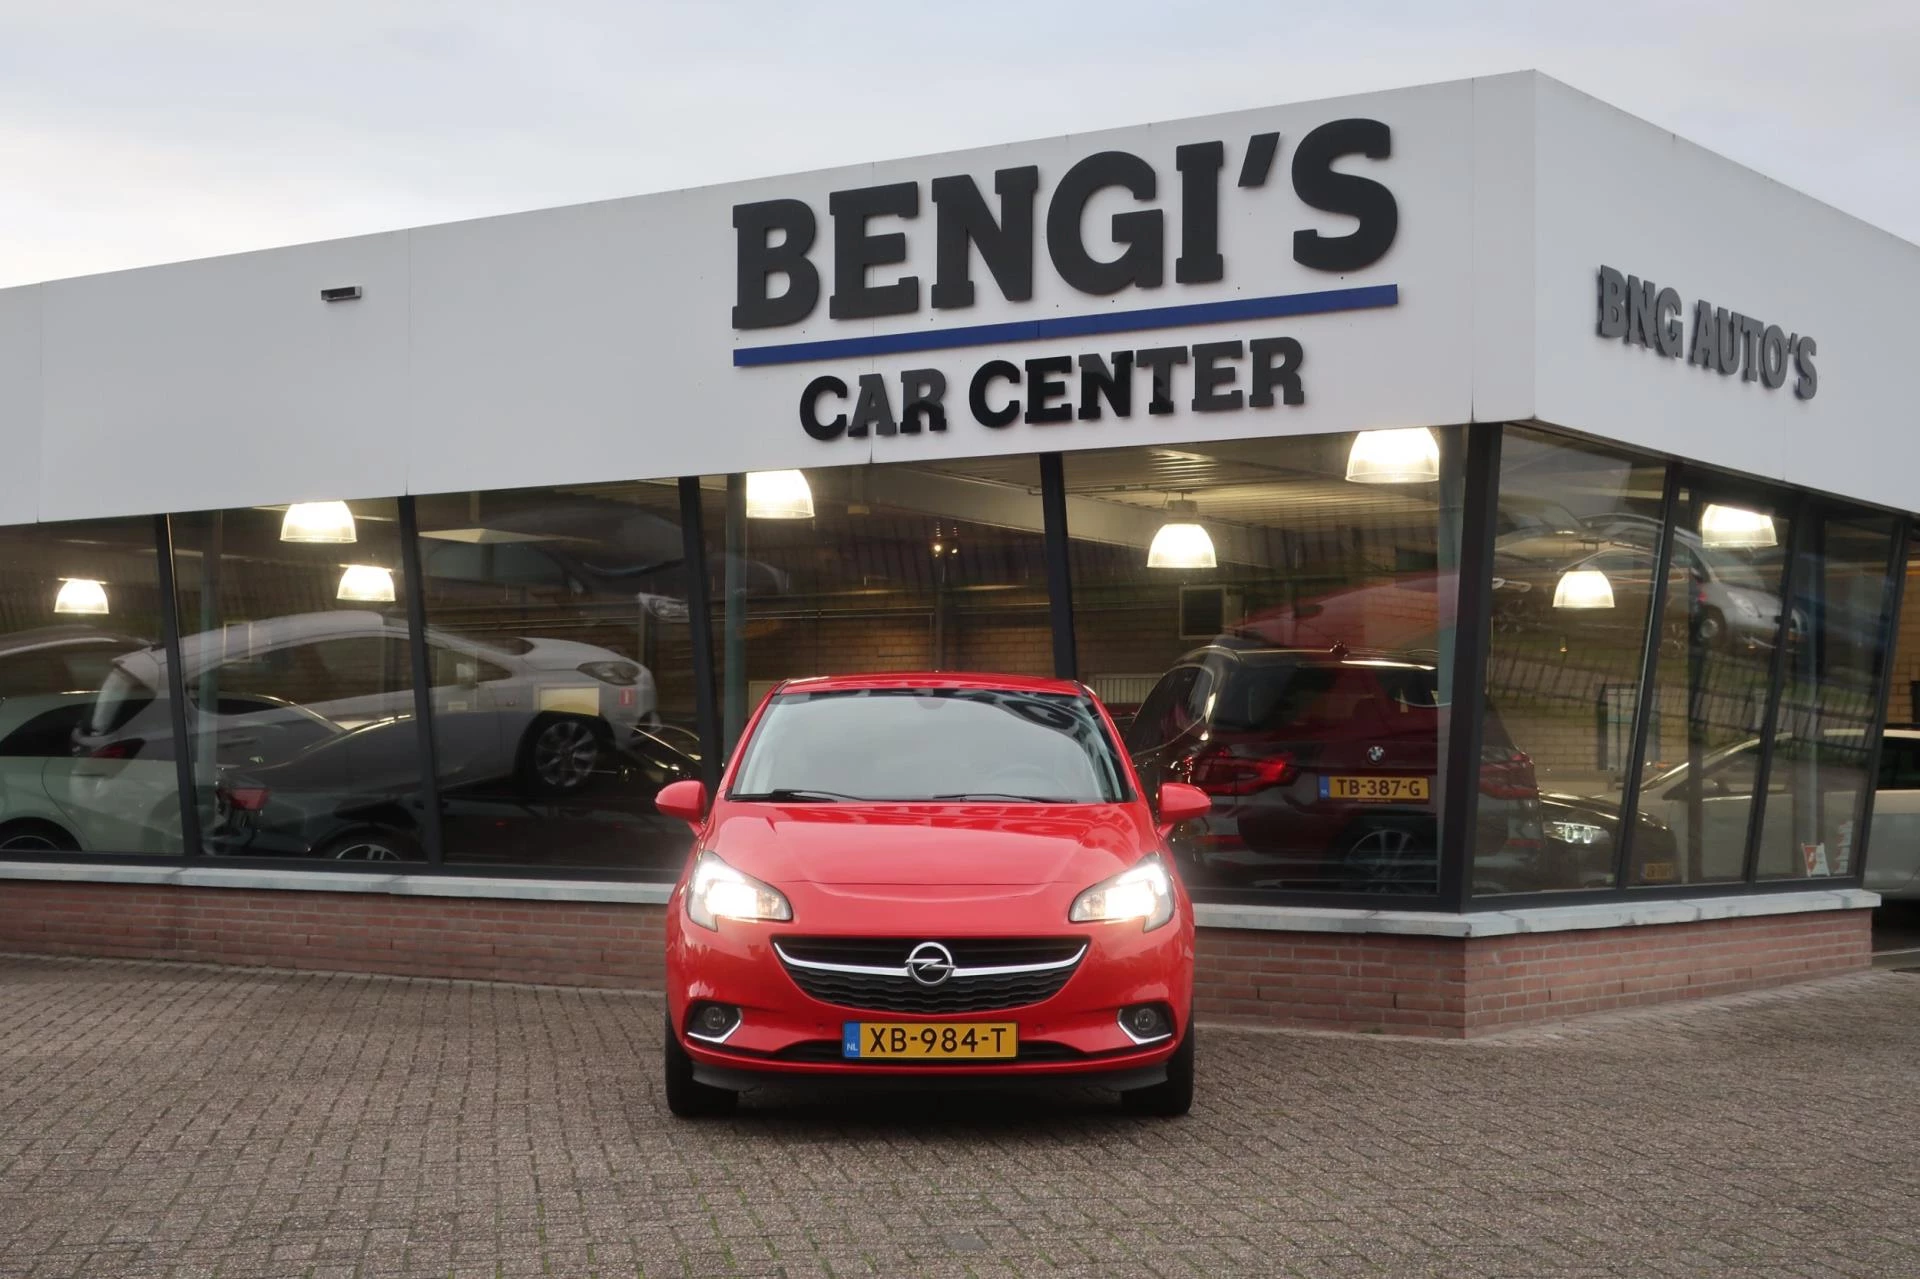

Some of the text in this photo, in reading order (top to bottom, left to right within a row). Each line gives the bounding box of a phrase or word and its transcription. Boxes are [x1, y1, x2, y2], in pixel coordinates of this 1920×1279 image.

[732, 118, 1399, 330] BENGI'S
[1598, 264, 1818, 401] BNG AUTO'S
[799, 336, 1305, 441] CAR CENTER
[1336, 778, 1421, 797] TB-387-G
[846, 1027, 1007, 1054] NL XB-984-T
